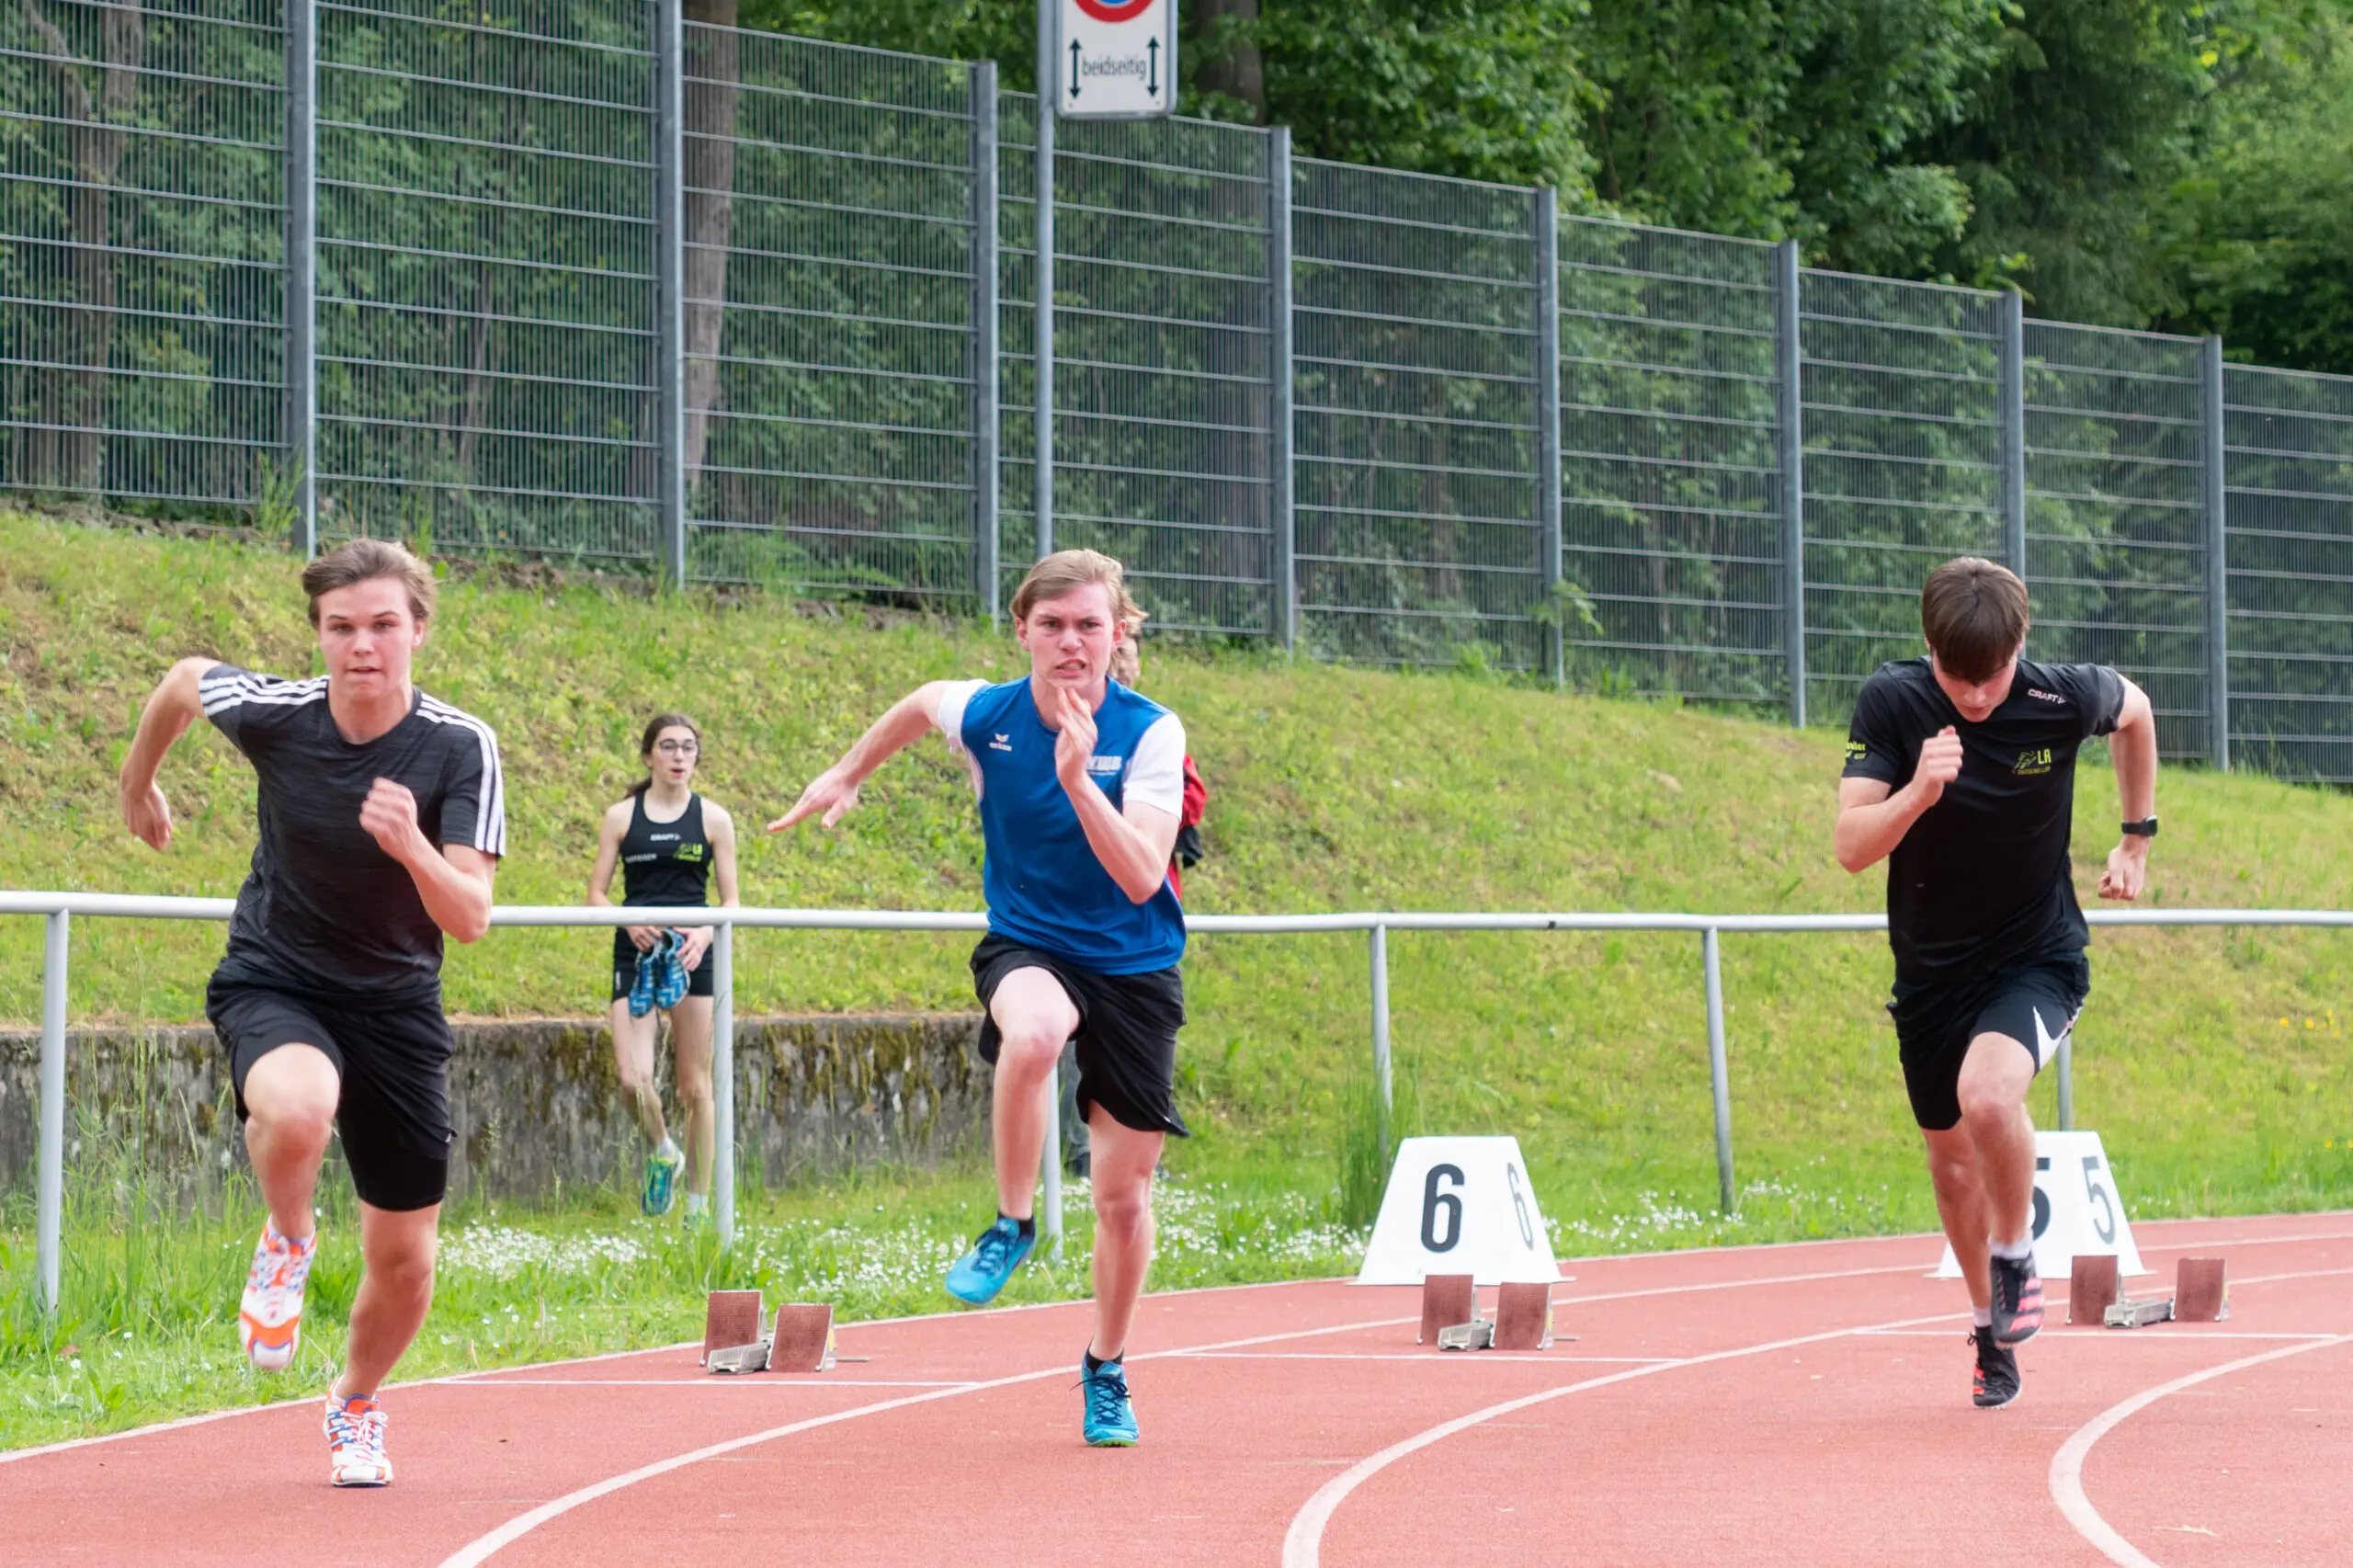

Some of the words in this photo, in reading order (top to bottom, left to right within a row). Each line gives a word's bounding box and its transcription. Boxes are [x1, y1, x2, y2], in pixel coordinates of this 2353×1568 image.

[1082, 55, 1147, 81] beidseitig
[2028, 688, 2059, 702] CRAFT
[2037, 748, 2052, 765] LA
[1421, 1163, 1465, 1254] 6
[1506, 1162, 1534, 1251] 6
[2081, 1155, 2115, 1244] 5
